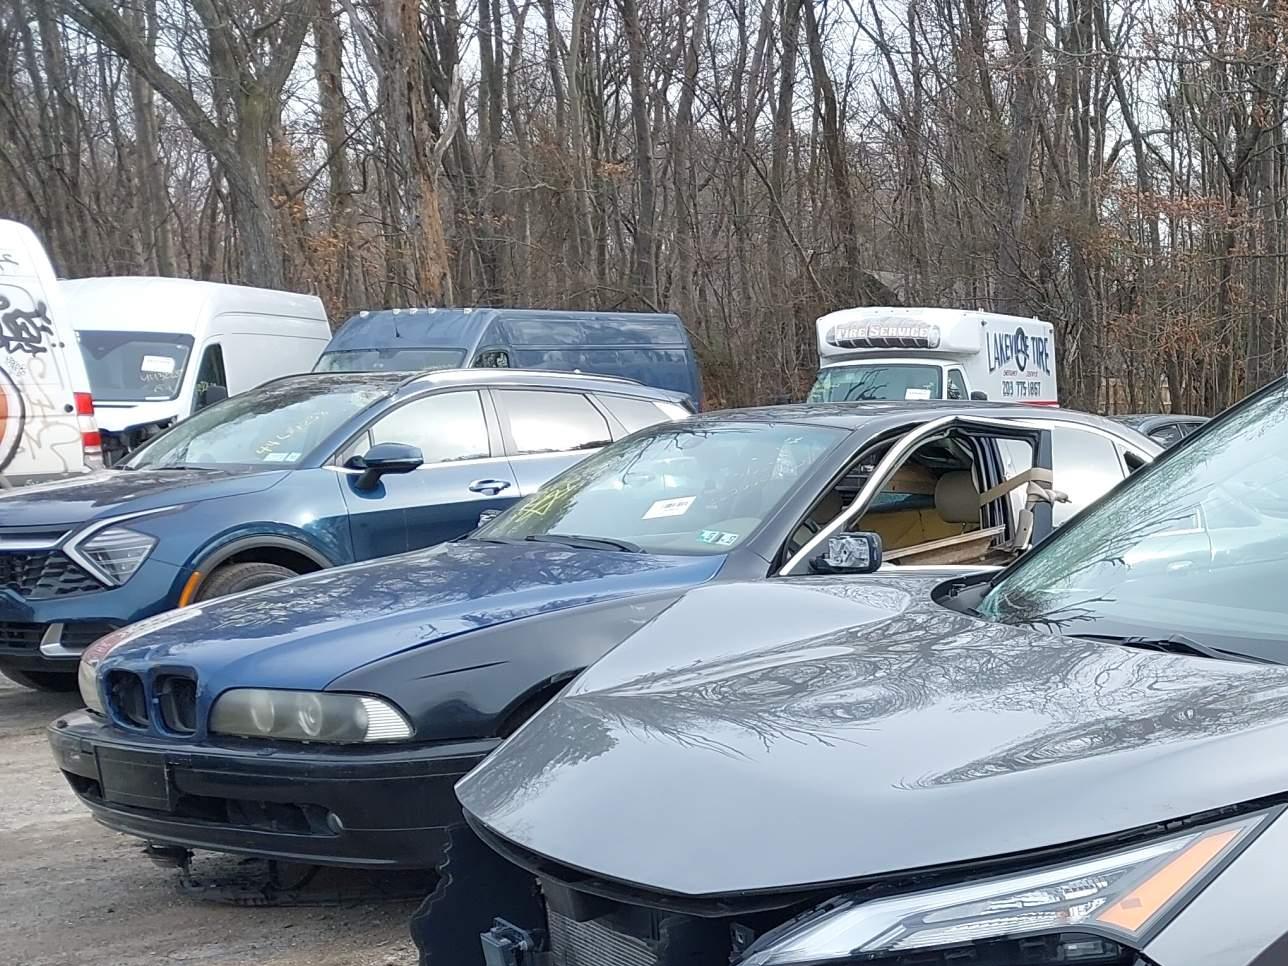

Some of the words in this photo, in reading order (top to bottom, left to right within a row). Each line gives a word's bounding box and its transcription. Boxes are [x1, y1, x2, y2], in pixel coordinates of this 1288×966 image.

[836, 327, 866, 339] TIRE
[868, 324, 928, 338] SERVICE
[1031, 335, 1051, 377] TIRE
[1002, 381, 1014, 397] 203
[1016, 381, 1027, 397] 775
